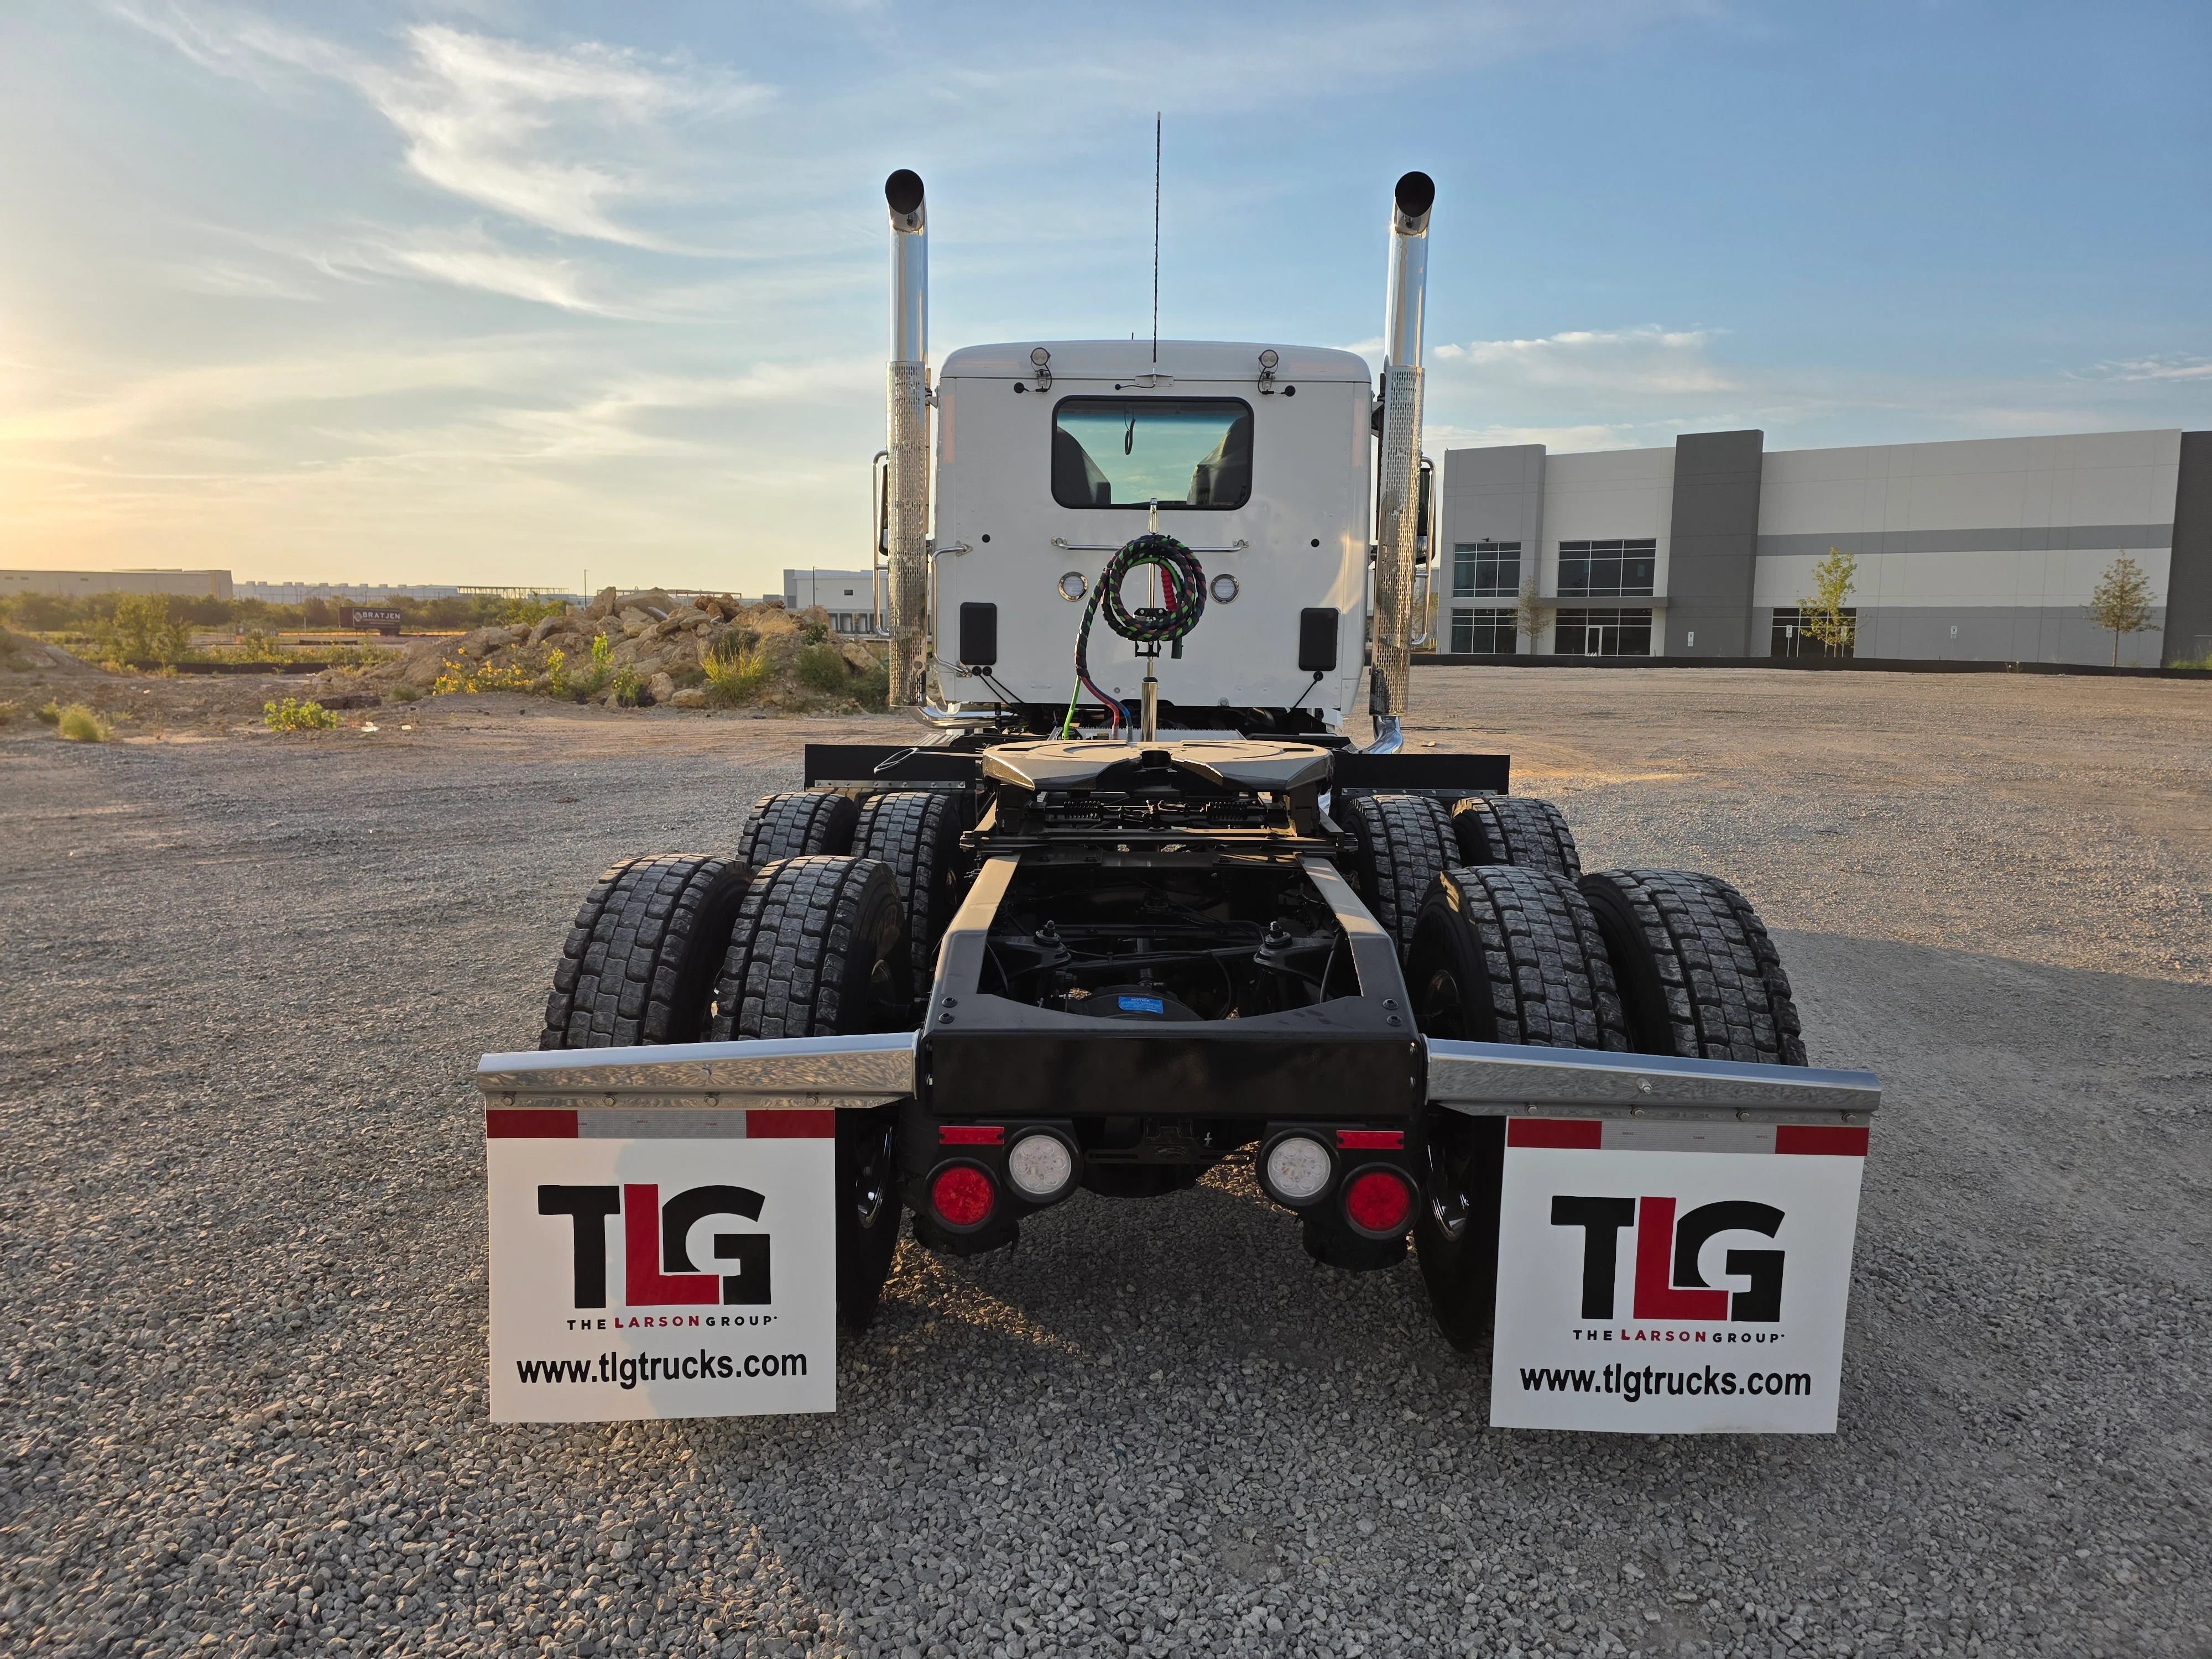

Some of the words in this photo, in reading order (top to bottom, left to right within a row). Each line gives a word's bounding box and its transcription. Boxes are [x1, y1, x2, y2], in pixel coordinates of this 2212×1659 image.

[538, 1183, 771, 1308] TLG
[1550, 1195, 1786, 1322] TLG
[566, 1319, 606, 1331] THE
[614, 1316, 700, 1329] LARSON
[706, 1316, 772, 1327] GROUP
[1573, 1329, 1613, 1341] THE
[1621, 1329, 1706, 1343] LARSON
[1712, 1333, 1779, 1343] GROUP
[517, 1349, 807, 1390] www.tlgtrucks.com
[1520, 1364, 1811, 1403] www.tlgtrucks.com
